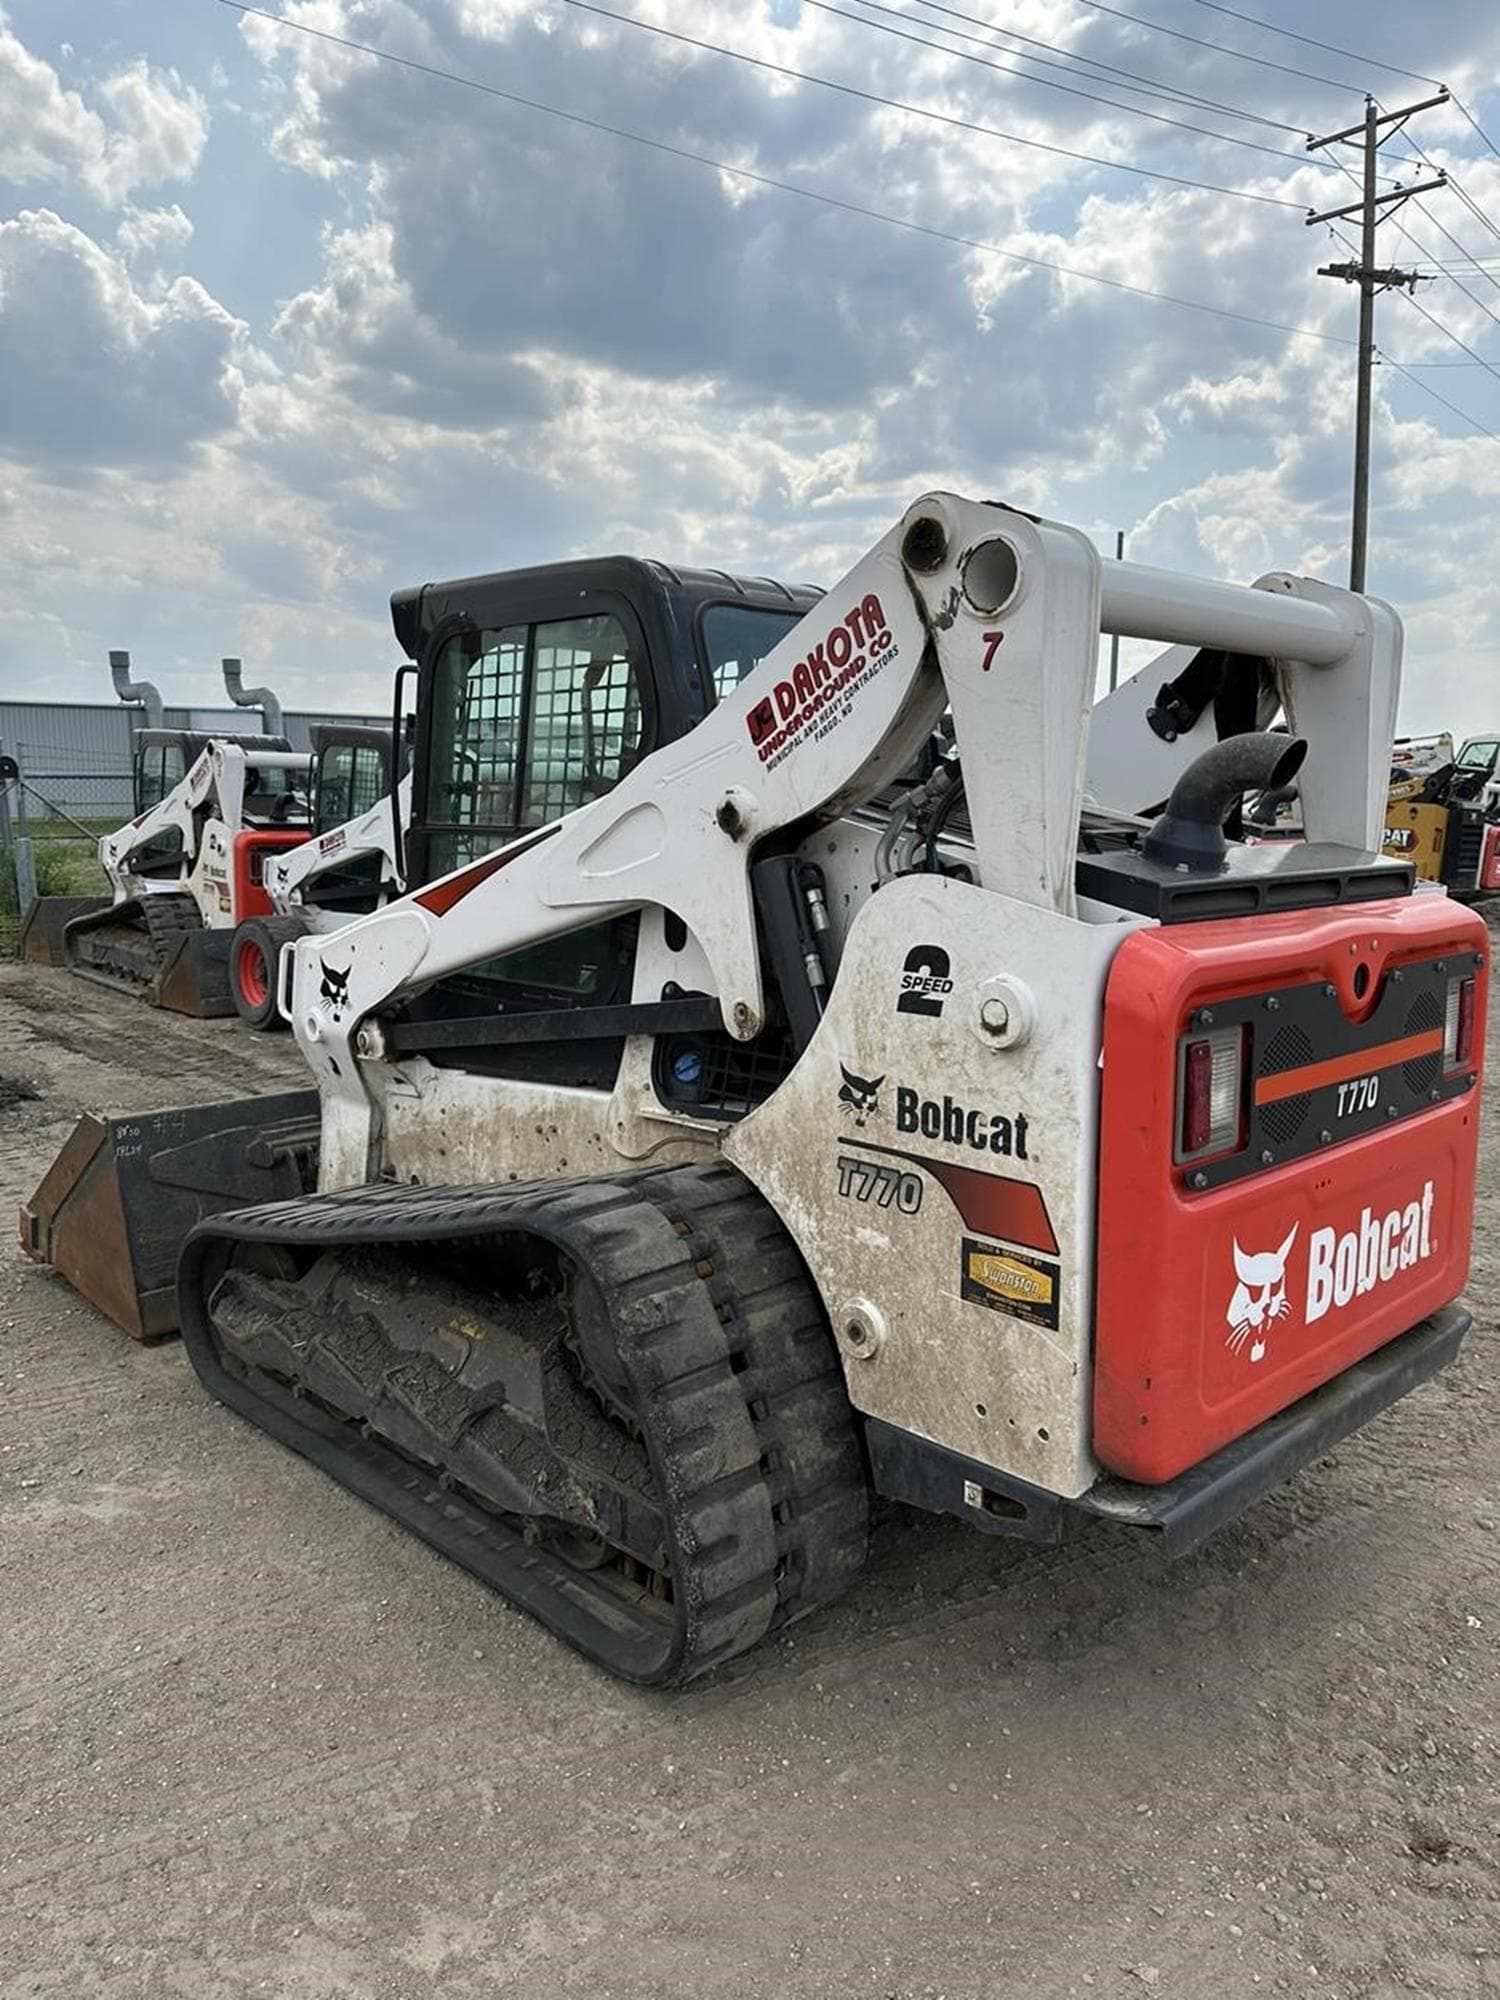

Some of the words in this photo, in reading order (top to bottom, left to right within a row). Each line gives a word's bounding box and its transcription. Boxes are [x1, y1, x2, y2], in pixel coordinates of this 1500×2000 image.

[774, 594, 886, 721] DAKOTA
[982, 631, 1004, 671] 7
[757, 655, 866, 762] UNDERGROUND
[870, 630, 892, 657] CO
[766, 735, 803, 773] MUNICIPAL
[804, 719, 819, 739] AND
[818, 695, 843, 724] HEAVY
[843, 644, 900, 701] CONTRACTORS
[841, 702, 854, 718] ND
[1382, 828, 1411, 847] CAT
[897, 944, 950, 1018] 2
[900, 975, 954, 994] SPEED
[896, 1086, 1029, 1160] Bobcat
[1336, 1074, 1379, 1118] T770
[837, 1156, 924, 1214] T770
[1305, 1179, 1434, 1325] Bobcat
